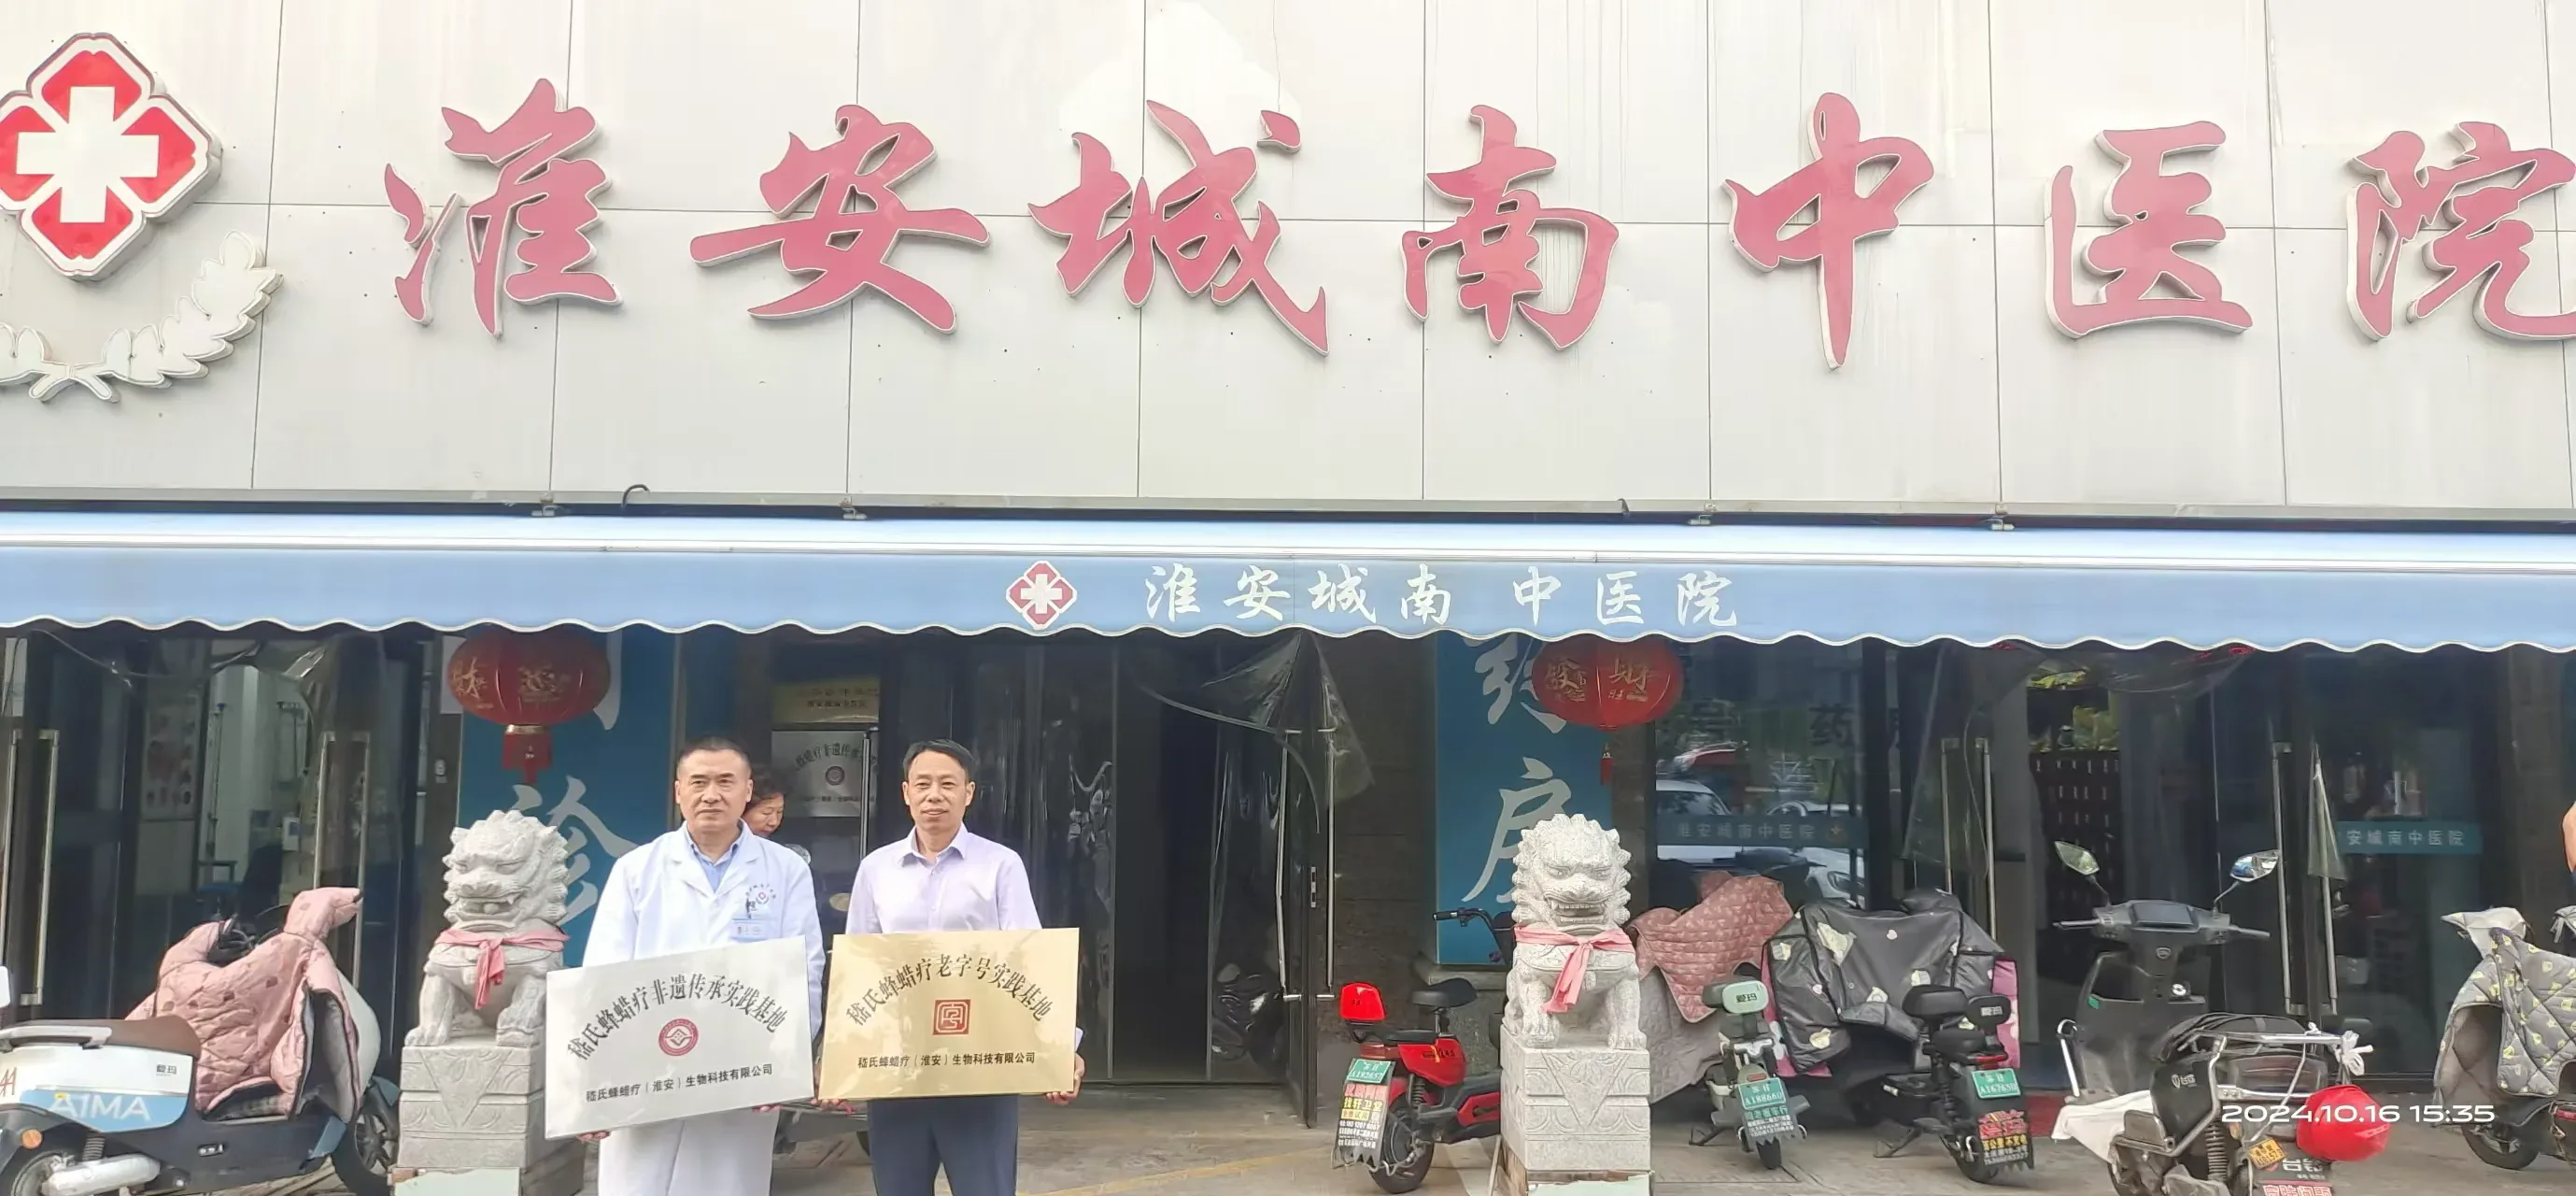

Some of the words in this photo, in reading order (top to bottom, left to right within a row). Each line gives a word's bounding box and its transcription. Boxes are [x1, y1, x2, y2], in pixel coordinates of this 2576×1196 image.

[384, 78, 2576, 369] 淮安城南中医院
[2337, 828, 2465, 847] 安城南中医院
